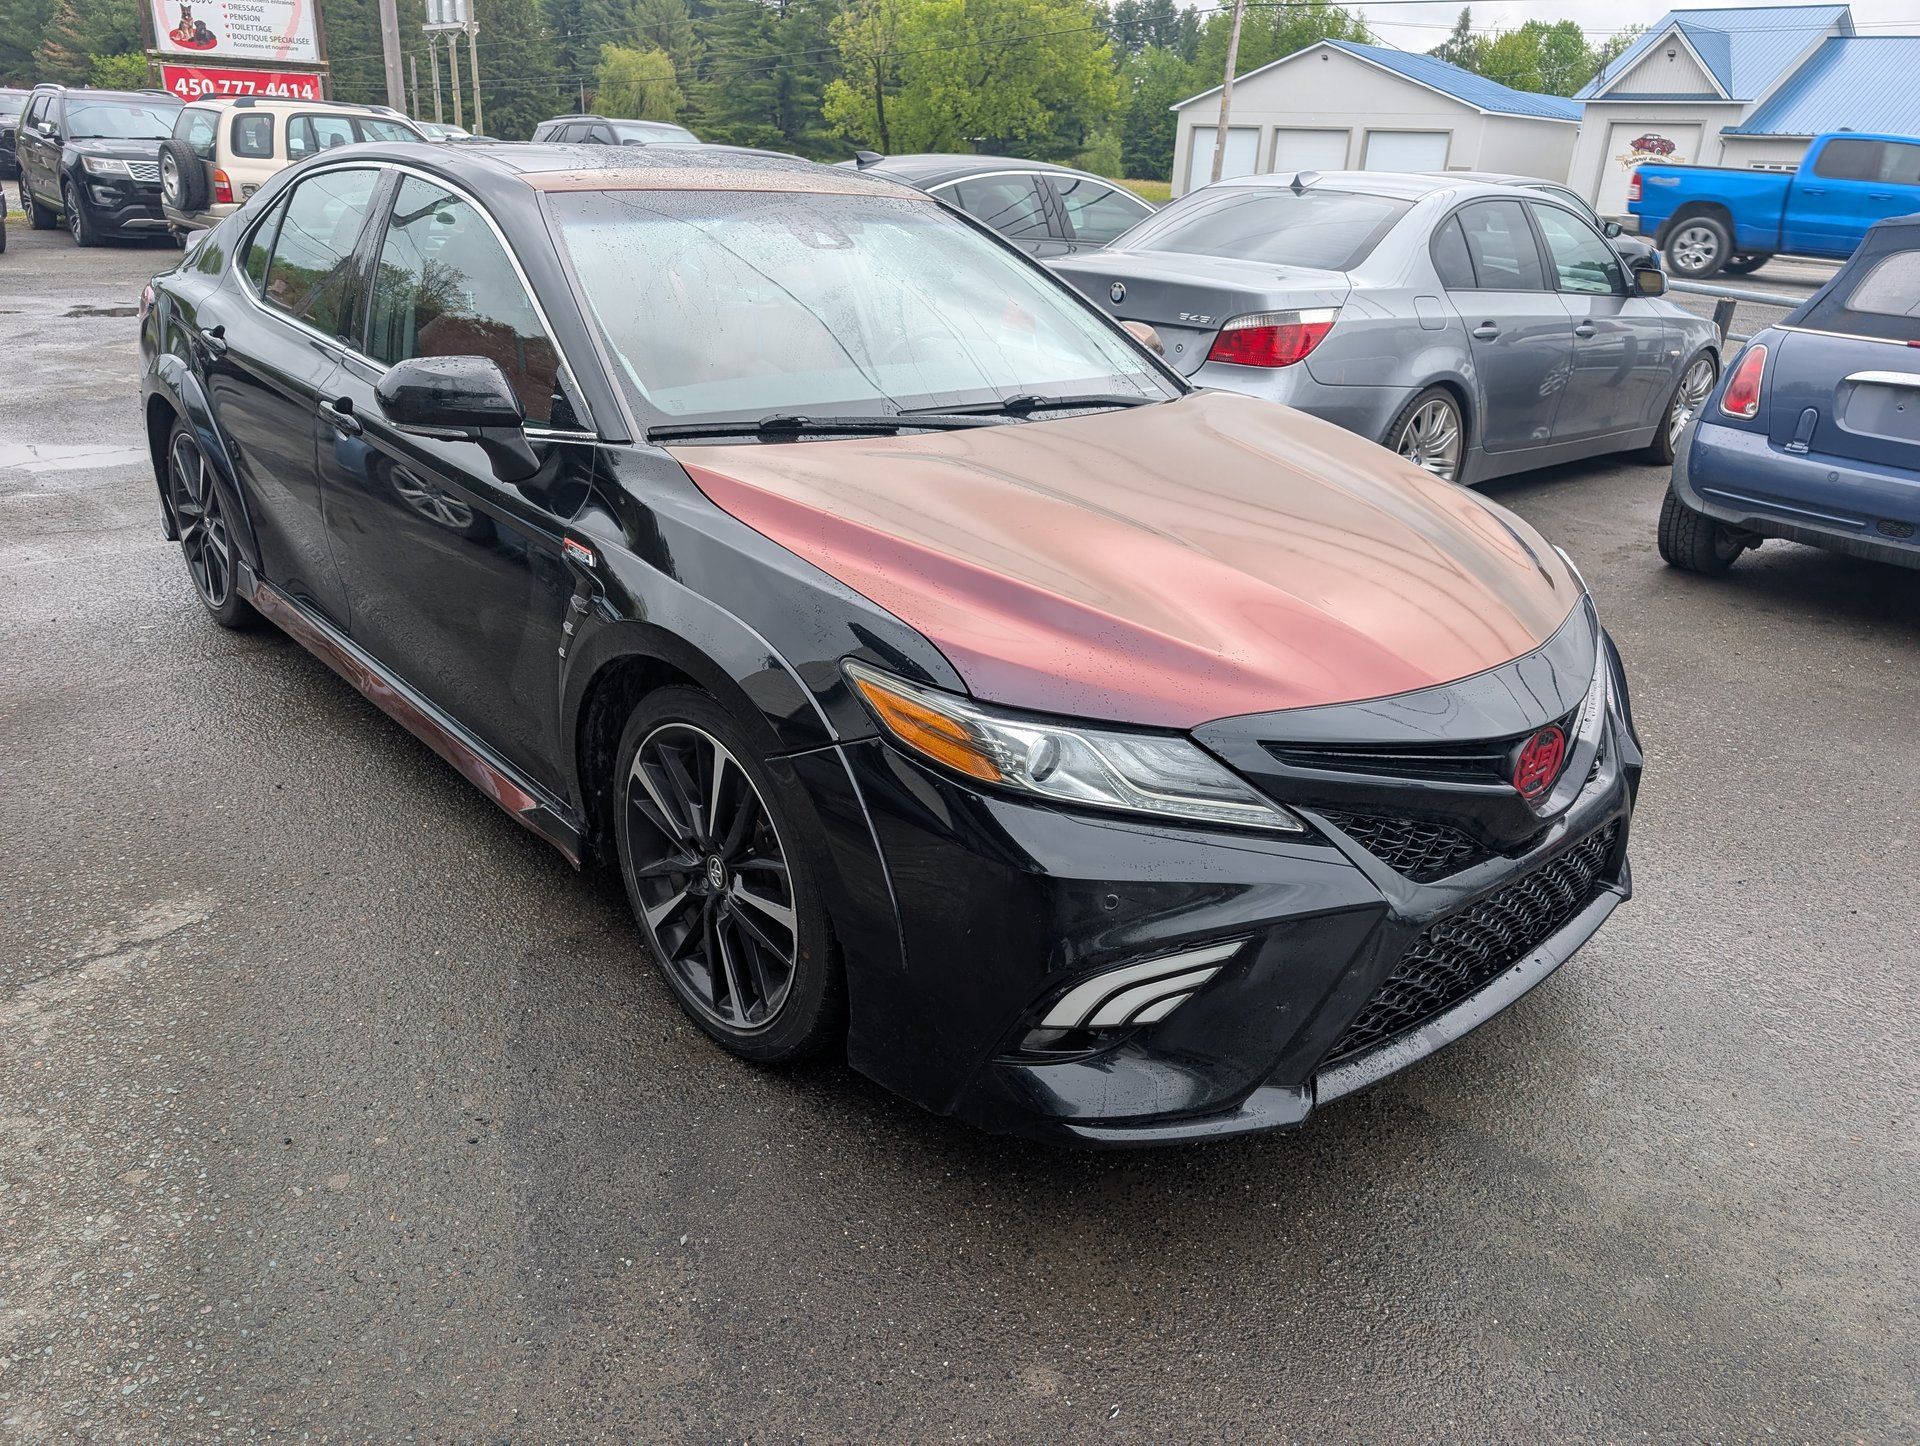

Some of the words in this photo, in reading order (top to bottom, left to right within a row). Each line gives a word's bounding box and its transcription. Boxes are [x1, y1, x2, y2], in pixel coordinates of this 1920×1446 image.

[228, 4, 265, 13] DRESSAGE
[229, 14, 261, 22] PENSION
[231, 23, 273, 33] TOILETTAGE
[232, 33, 268, 42] BOUTIQUE
[269, 35, 310, 45] SPÉCIALISÉE
[175, 78, 214, 96] 450
[218, 79, 314, 99] 777-4414
